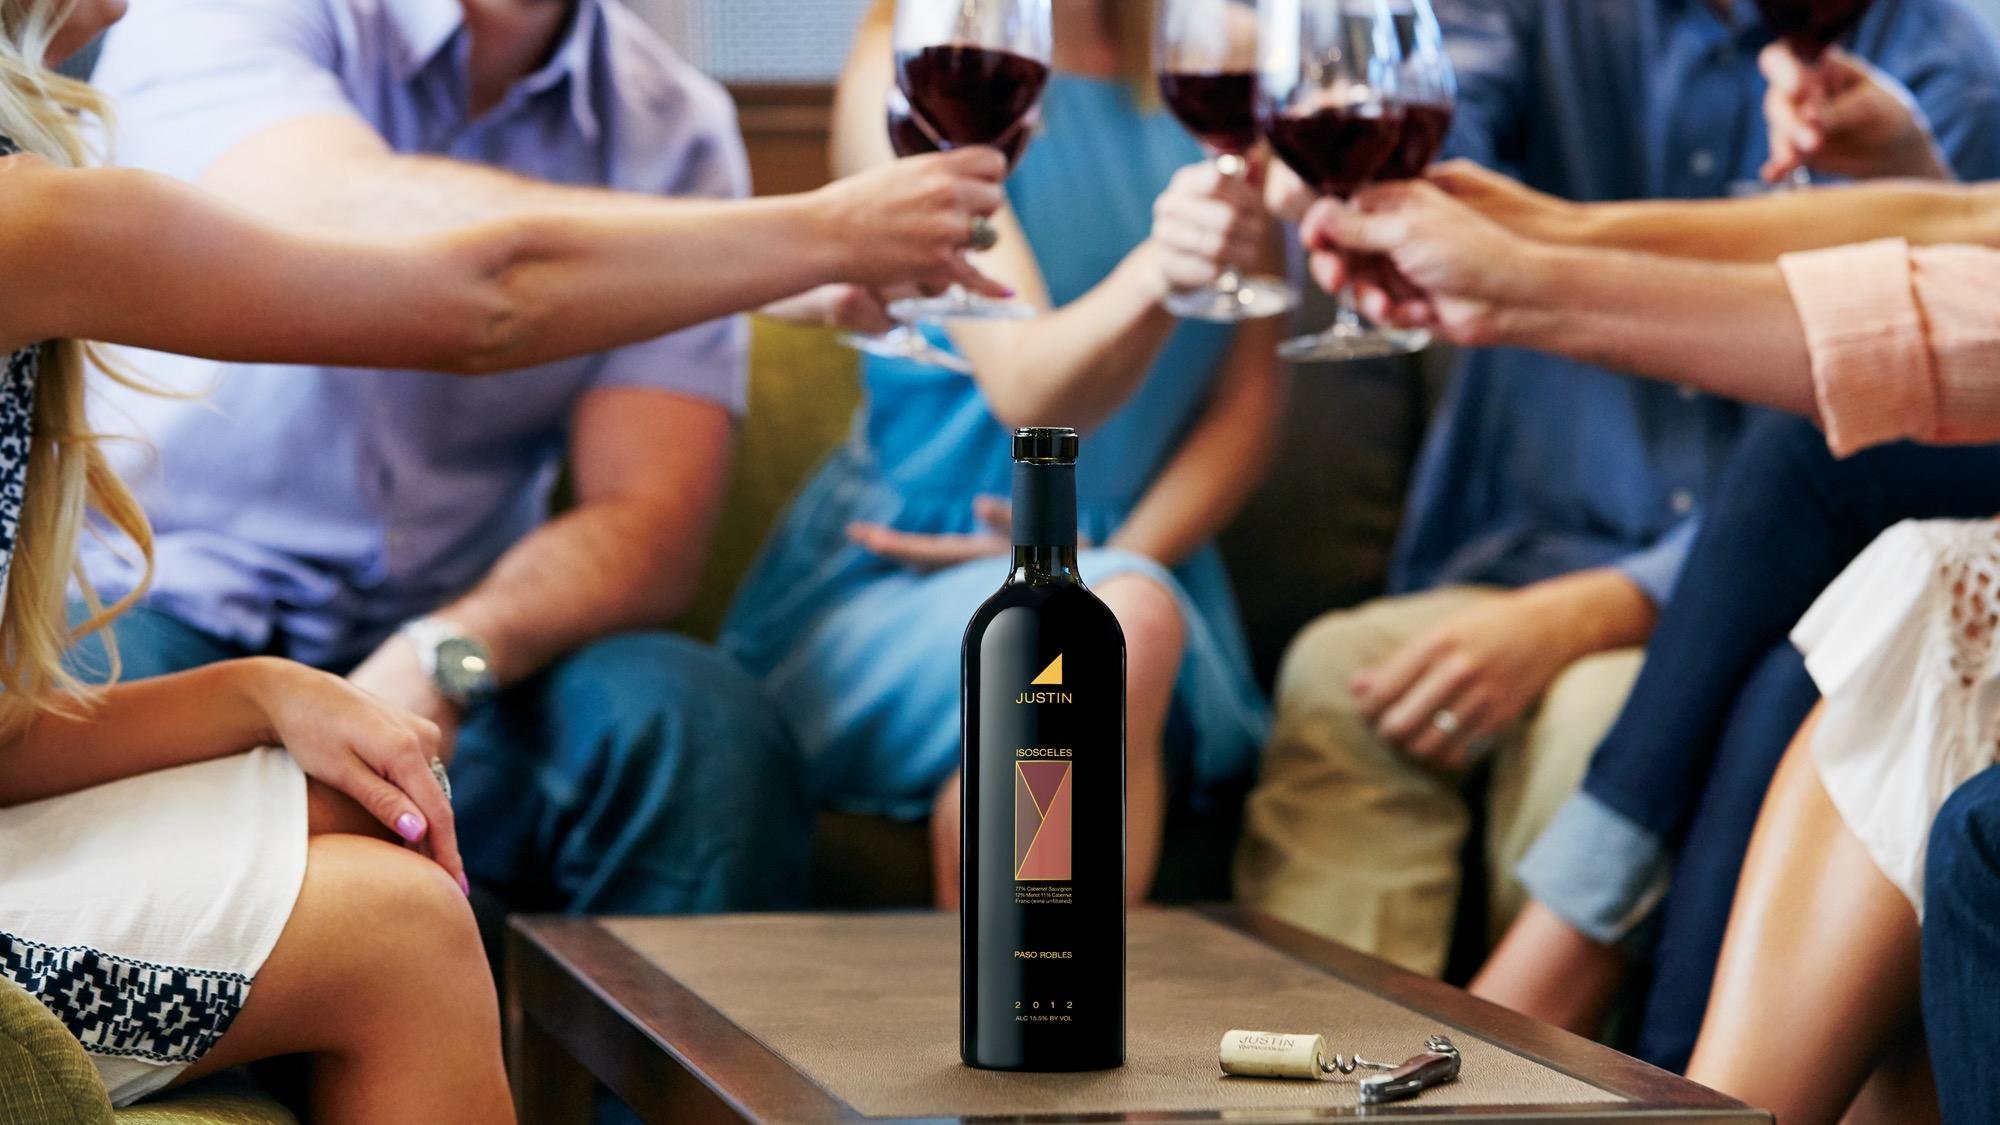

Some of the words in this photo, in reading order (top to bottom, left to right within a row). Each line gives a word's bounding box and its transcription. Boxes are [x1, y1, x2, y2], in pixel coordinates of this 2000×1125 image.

[1015, 692, 1072, 704] JUSTIN
[1015, 748, 1073, 757] ISOSCELES
[1014, 951, 1038, 959] PASO
[1040, 951, 1073, 959] ROBLES
